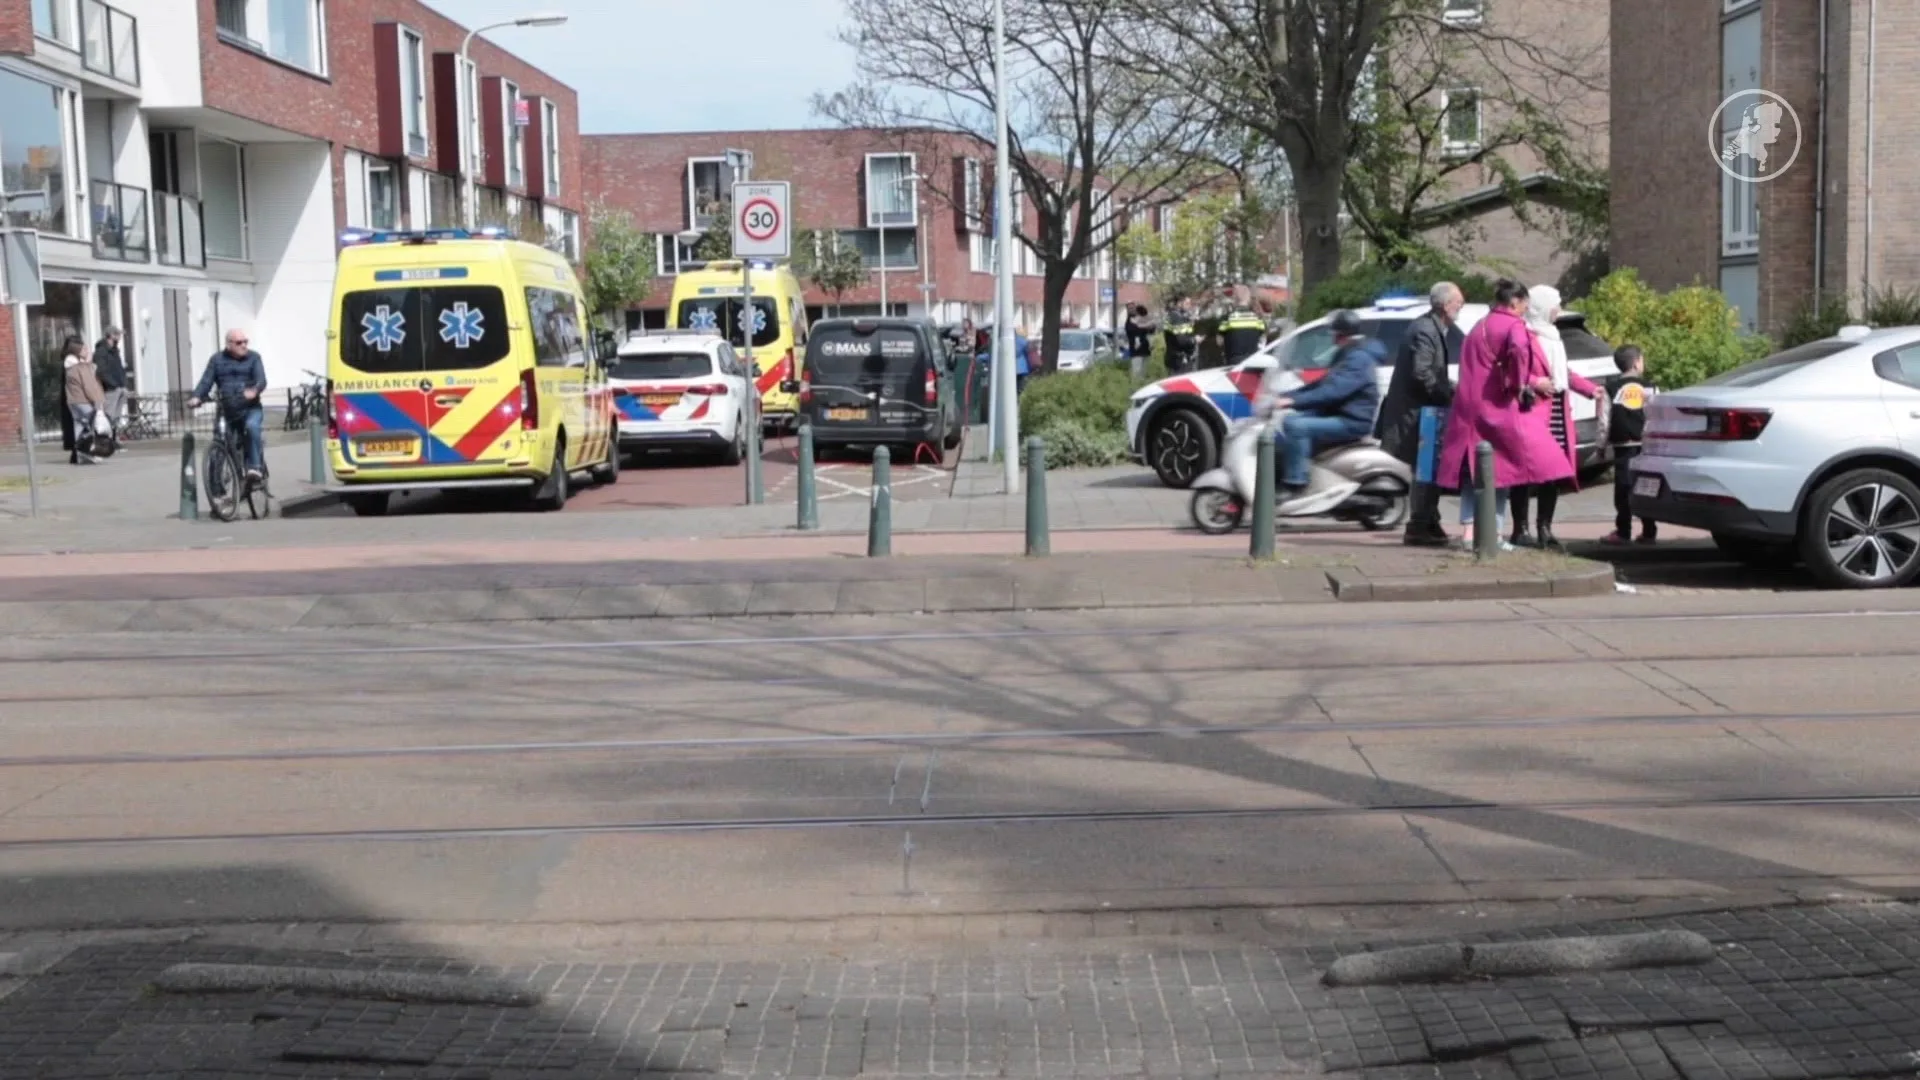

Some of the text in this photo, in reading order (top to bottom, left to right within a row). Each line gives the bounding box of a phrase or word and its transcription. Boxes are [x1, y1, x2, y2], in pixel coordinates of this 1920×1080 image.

[748, 188, 772, 196] ZONE
[748, 211, 774, 229] 30
[835, 342, 872, 354] MAAS
[335, 378, 418, 390] AMBULANCE
